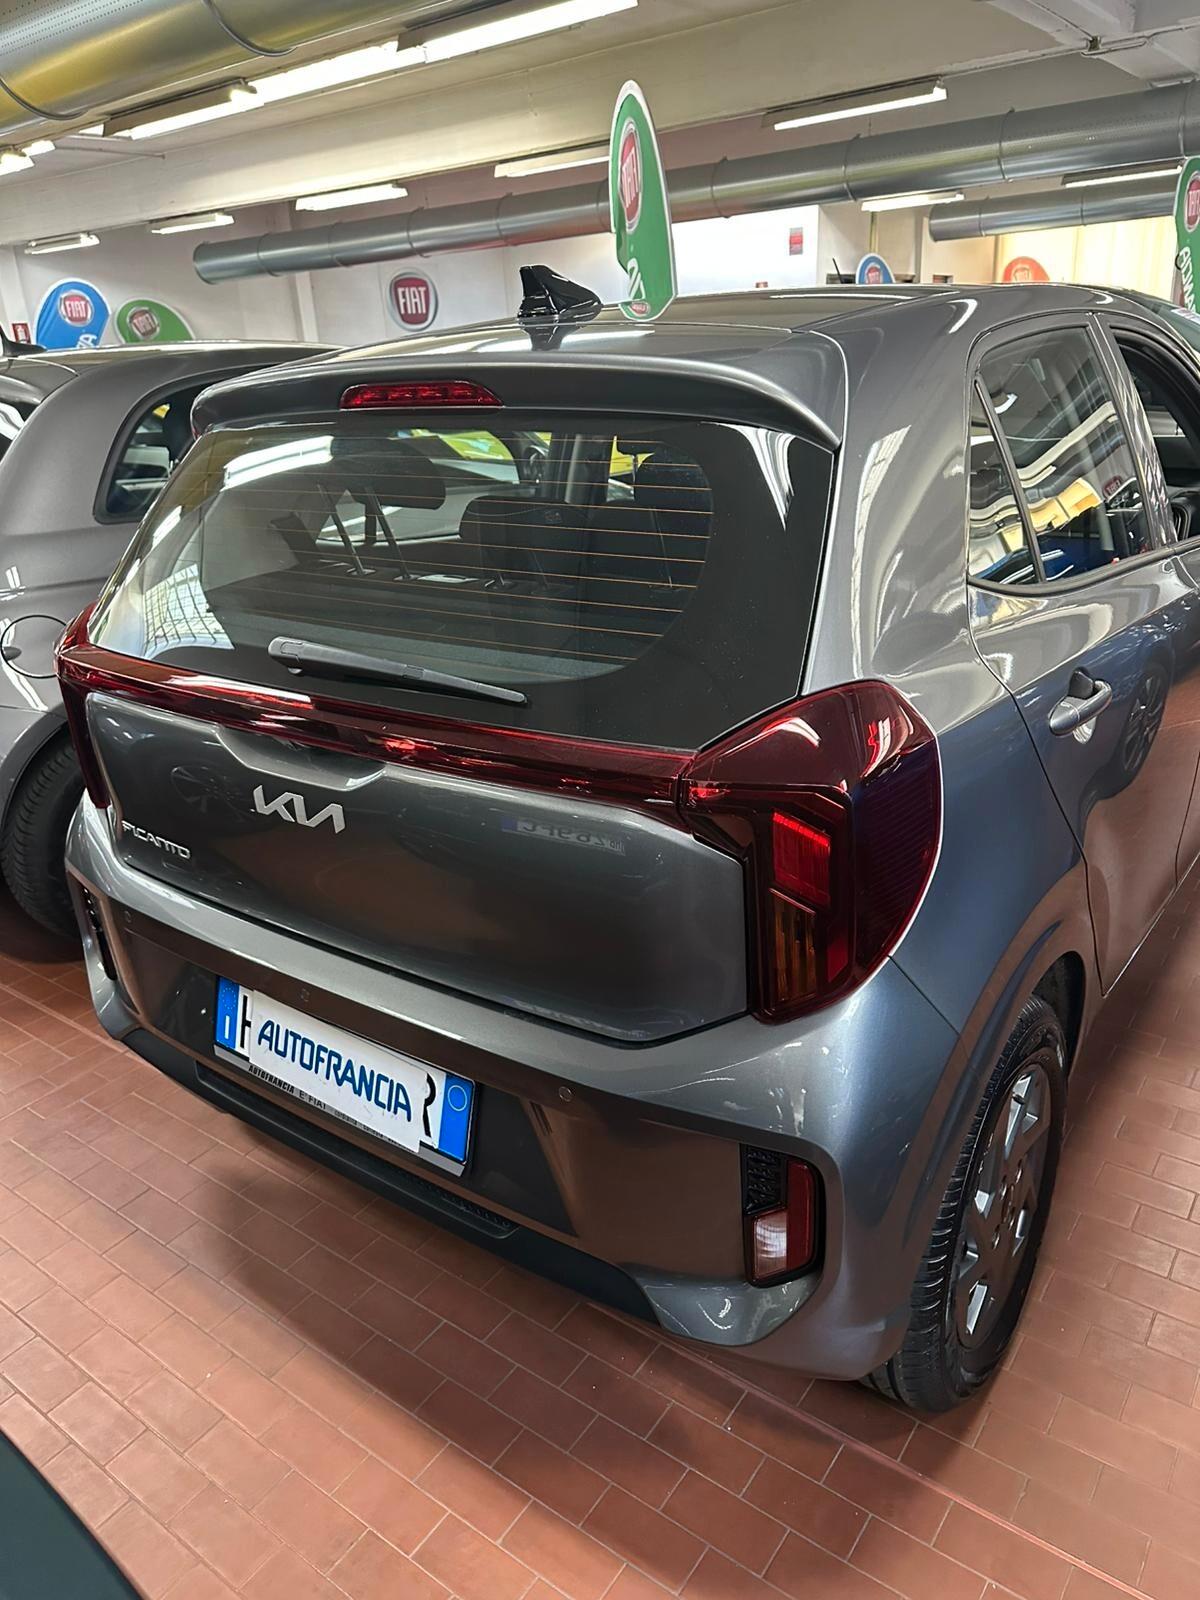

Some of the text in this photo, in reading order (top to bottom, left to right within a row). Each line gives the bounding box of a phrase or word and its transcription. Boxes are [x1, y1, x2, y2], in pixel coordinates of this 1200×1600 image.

[65, 302, 87, 319] FIAT
[397, 286, 427, 315] FIAT
[253, 785, 346, 834] KIA
[121, 820, 191, 859] PICANTO
[248, 1064, 295, 1094] AUTOFRANCIA
[257, 1019, 412, 1122] AUTOFRANCIA
